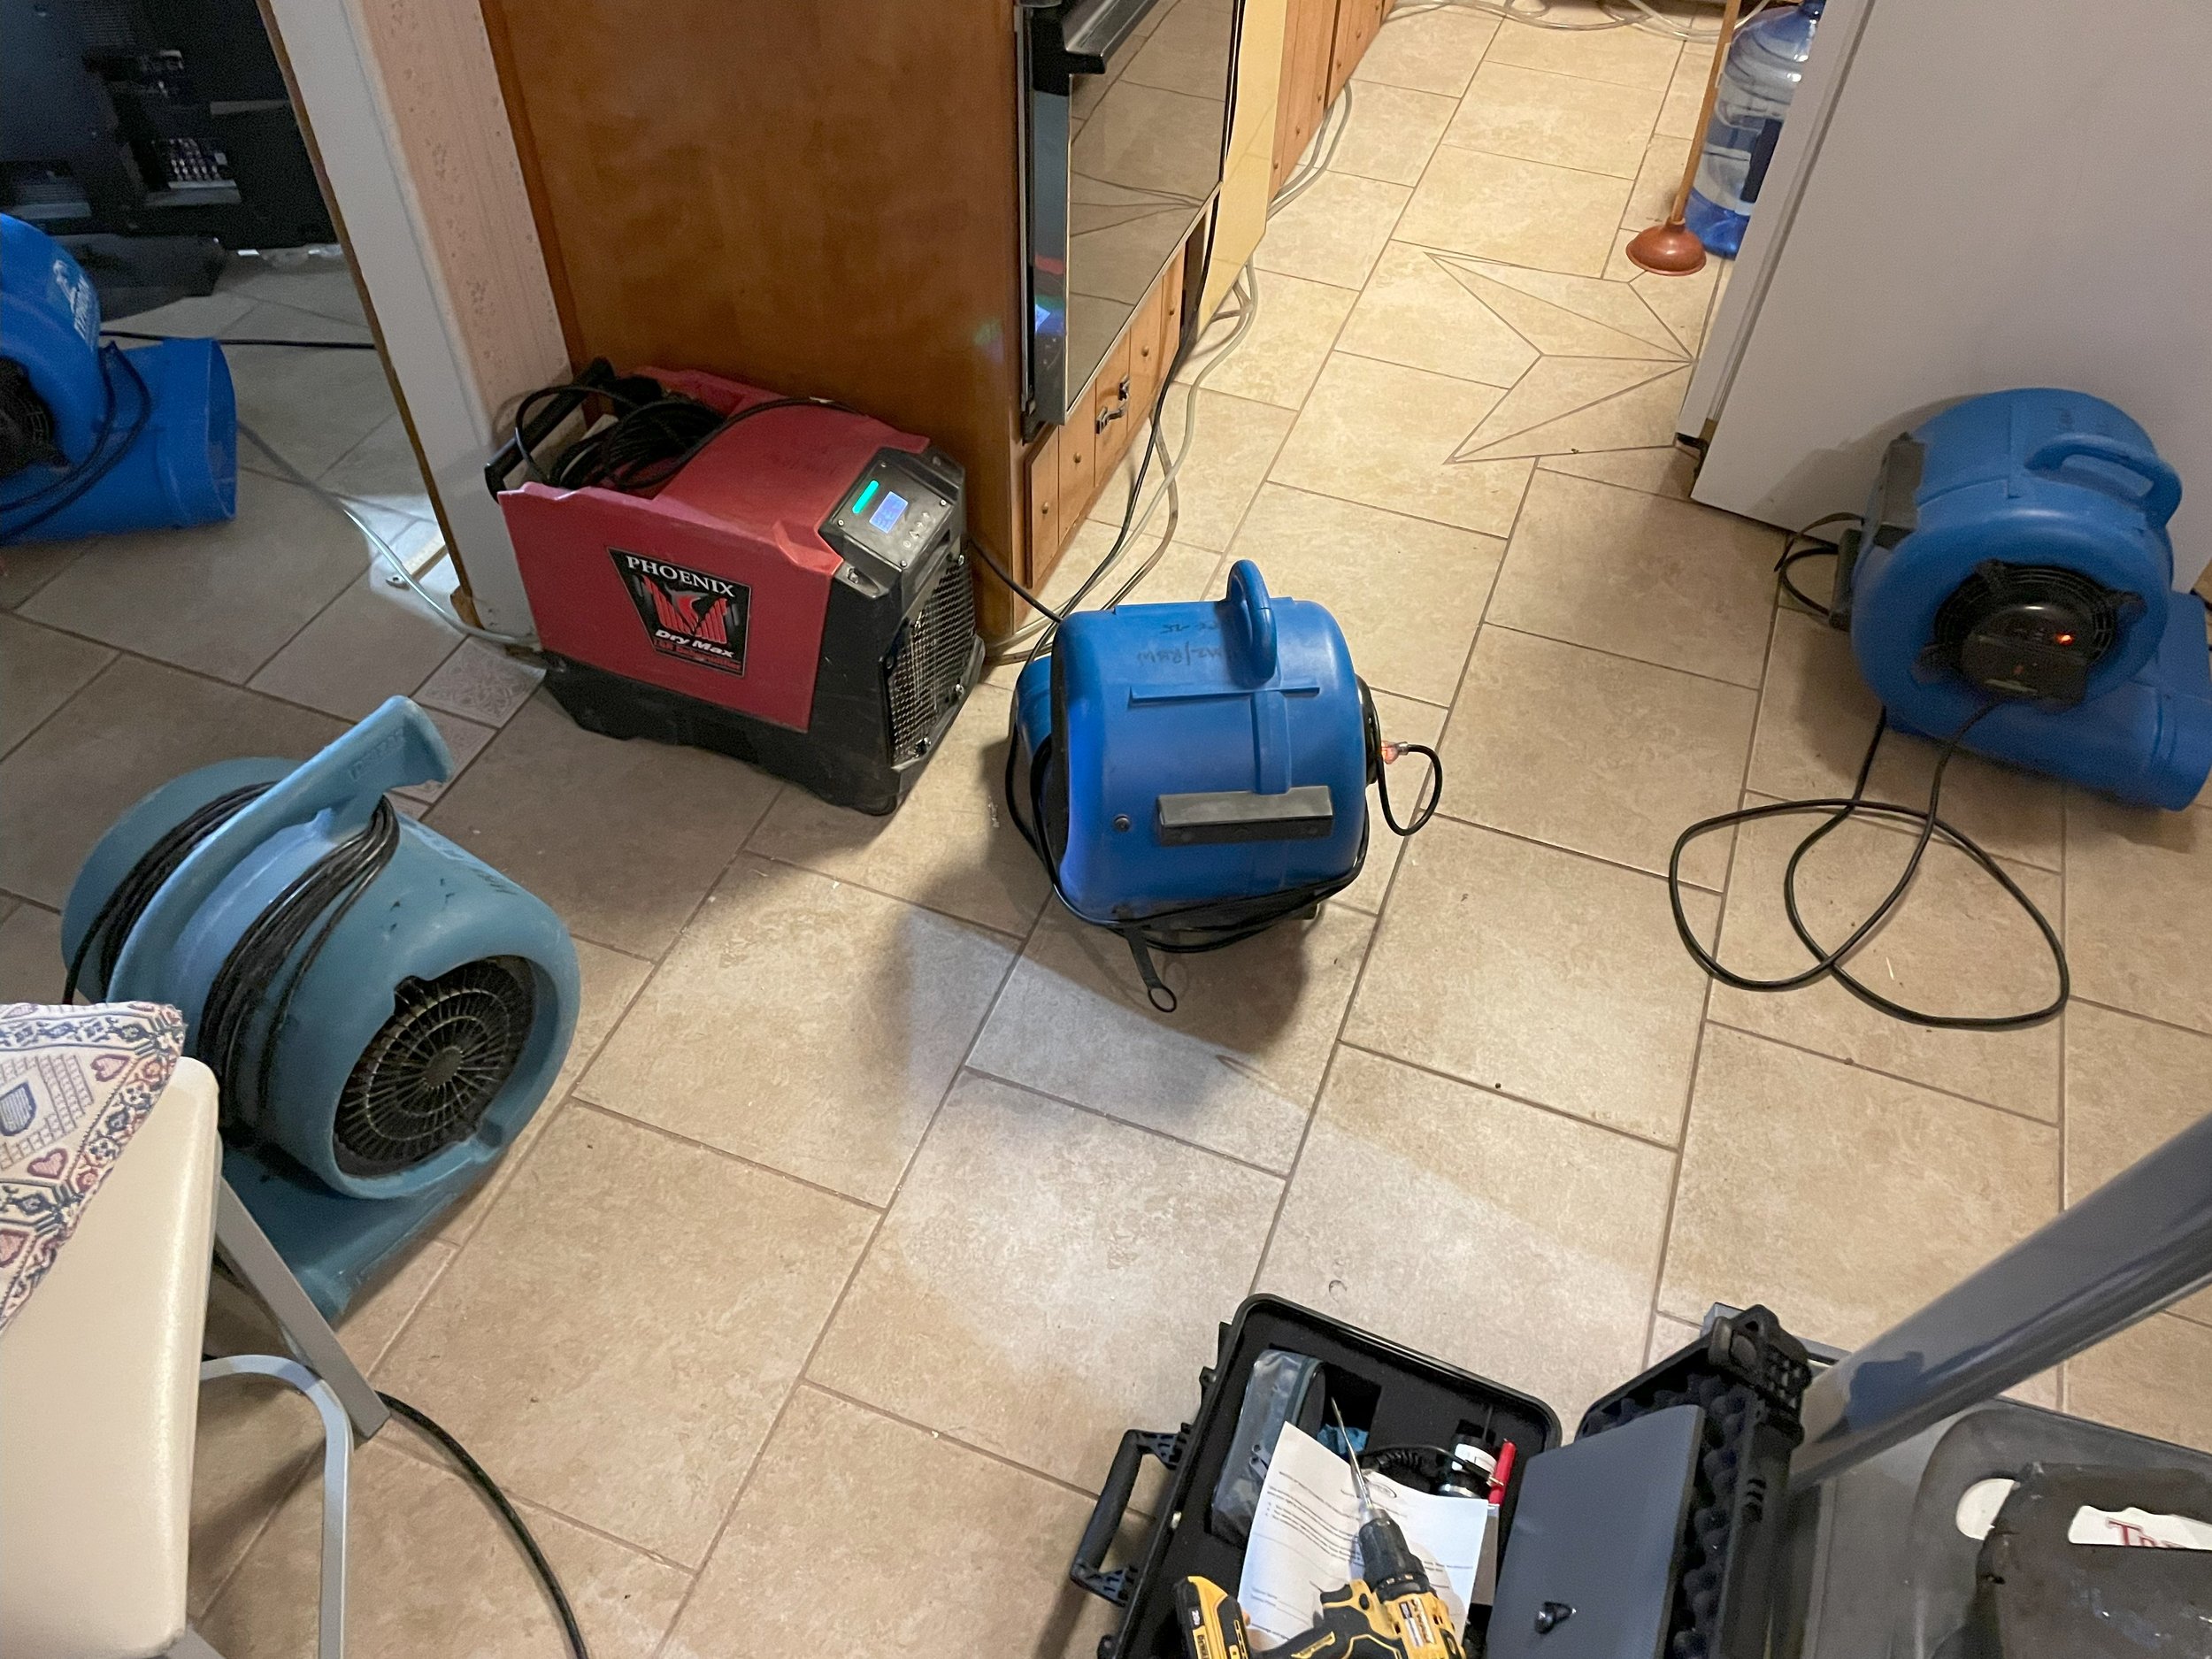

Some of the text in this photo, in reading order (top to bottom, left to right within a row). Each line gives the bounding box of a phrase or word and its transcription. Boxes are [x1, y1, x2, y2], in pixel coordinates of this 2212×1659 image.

[625, 555, 735, 597] PHOENIX
[655, 629, 690, 644] Dry
[692, 640, 734, 658] Max
